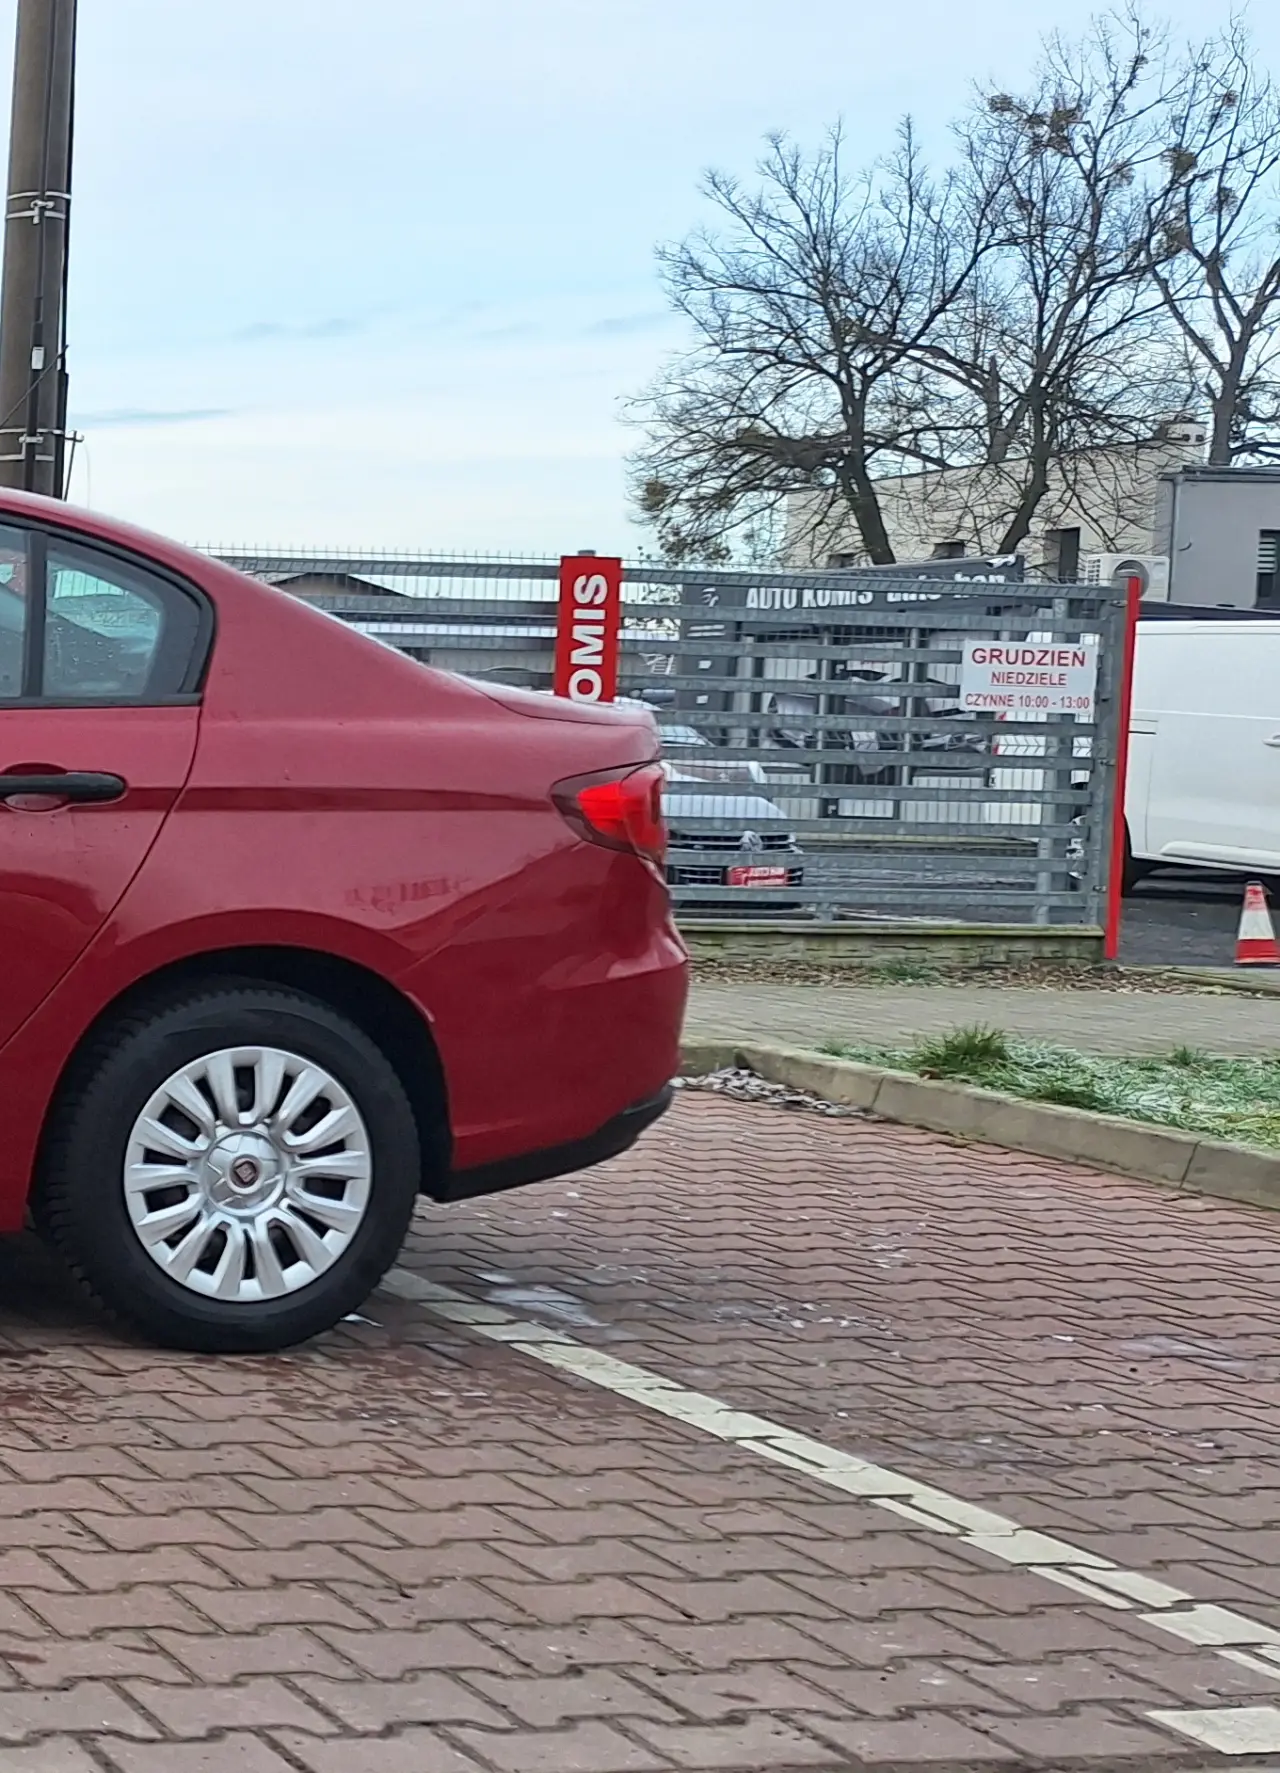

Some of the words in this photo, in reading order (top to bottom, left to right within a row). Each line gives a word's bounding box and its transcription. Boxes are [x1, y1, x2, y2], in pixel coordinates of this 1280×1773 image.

[746, 587, 797, 609] AUTO
[568, 574, 608, 702] OMIS
[990, 671, 1068, 686] NIEDZIELE
[965, 692, 1015, 707] CZYNNE
[1019, 695, 1049, 708] 10:00
[1060, 696, 1090, 709] 13:00
